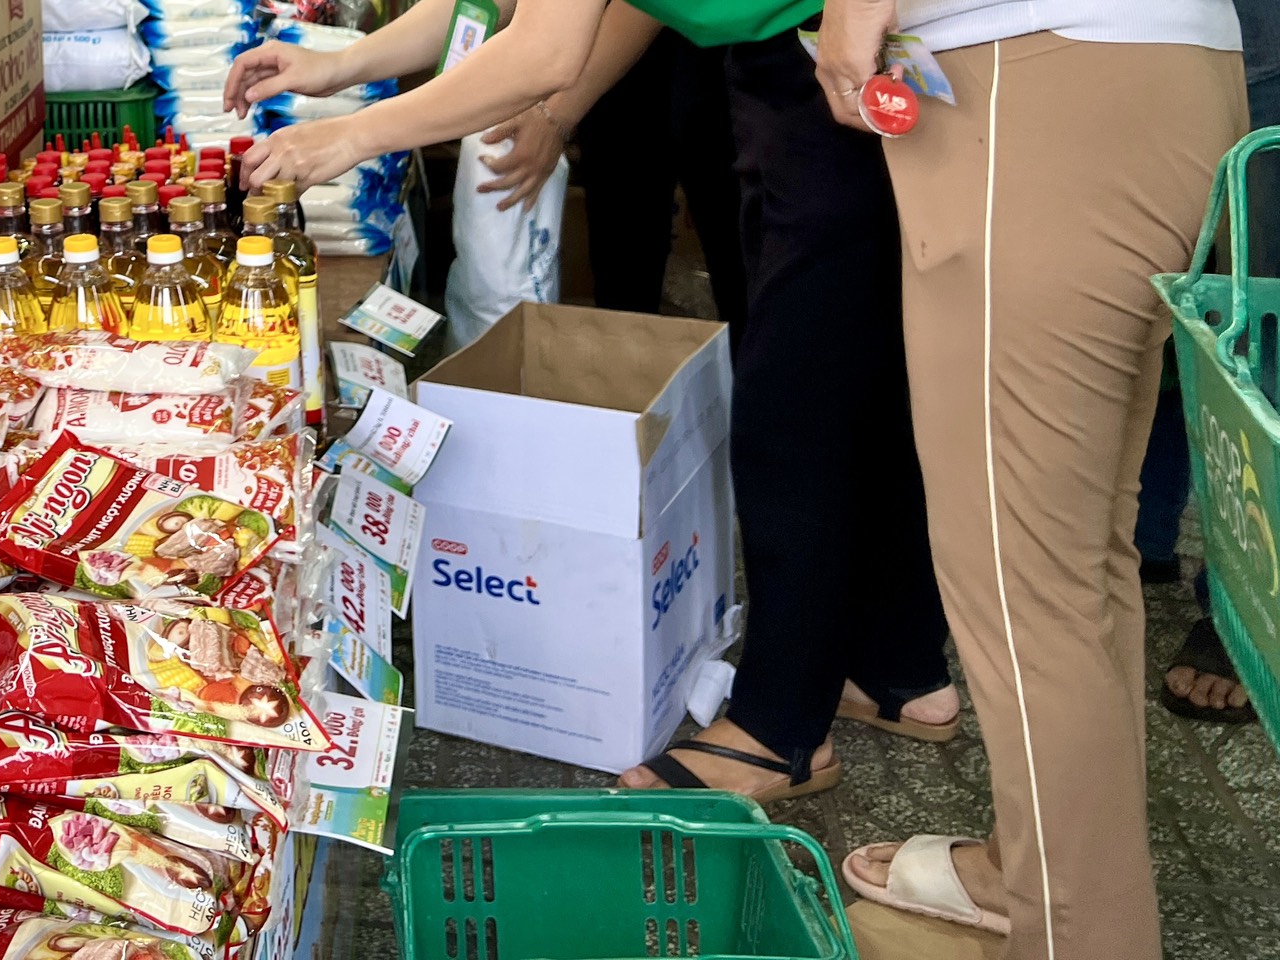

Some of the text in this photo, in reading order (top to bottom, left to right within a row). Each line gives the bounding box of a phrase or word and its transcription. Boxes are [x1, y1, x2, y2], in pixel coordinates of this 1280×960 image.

[98, 504, 121, 532] NGỌT
[116, 469, 148, 509] XƯƠNG
[340, 562, 356, 590] 000
[433, 558, 541, 605] Select
